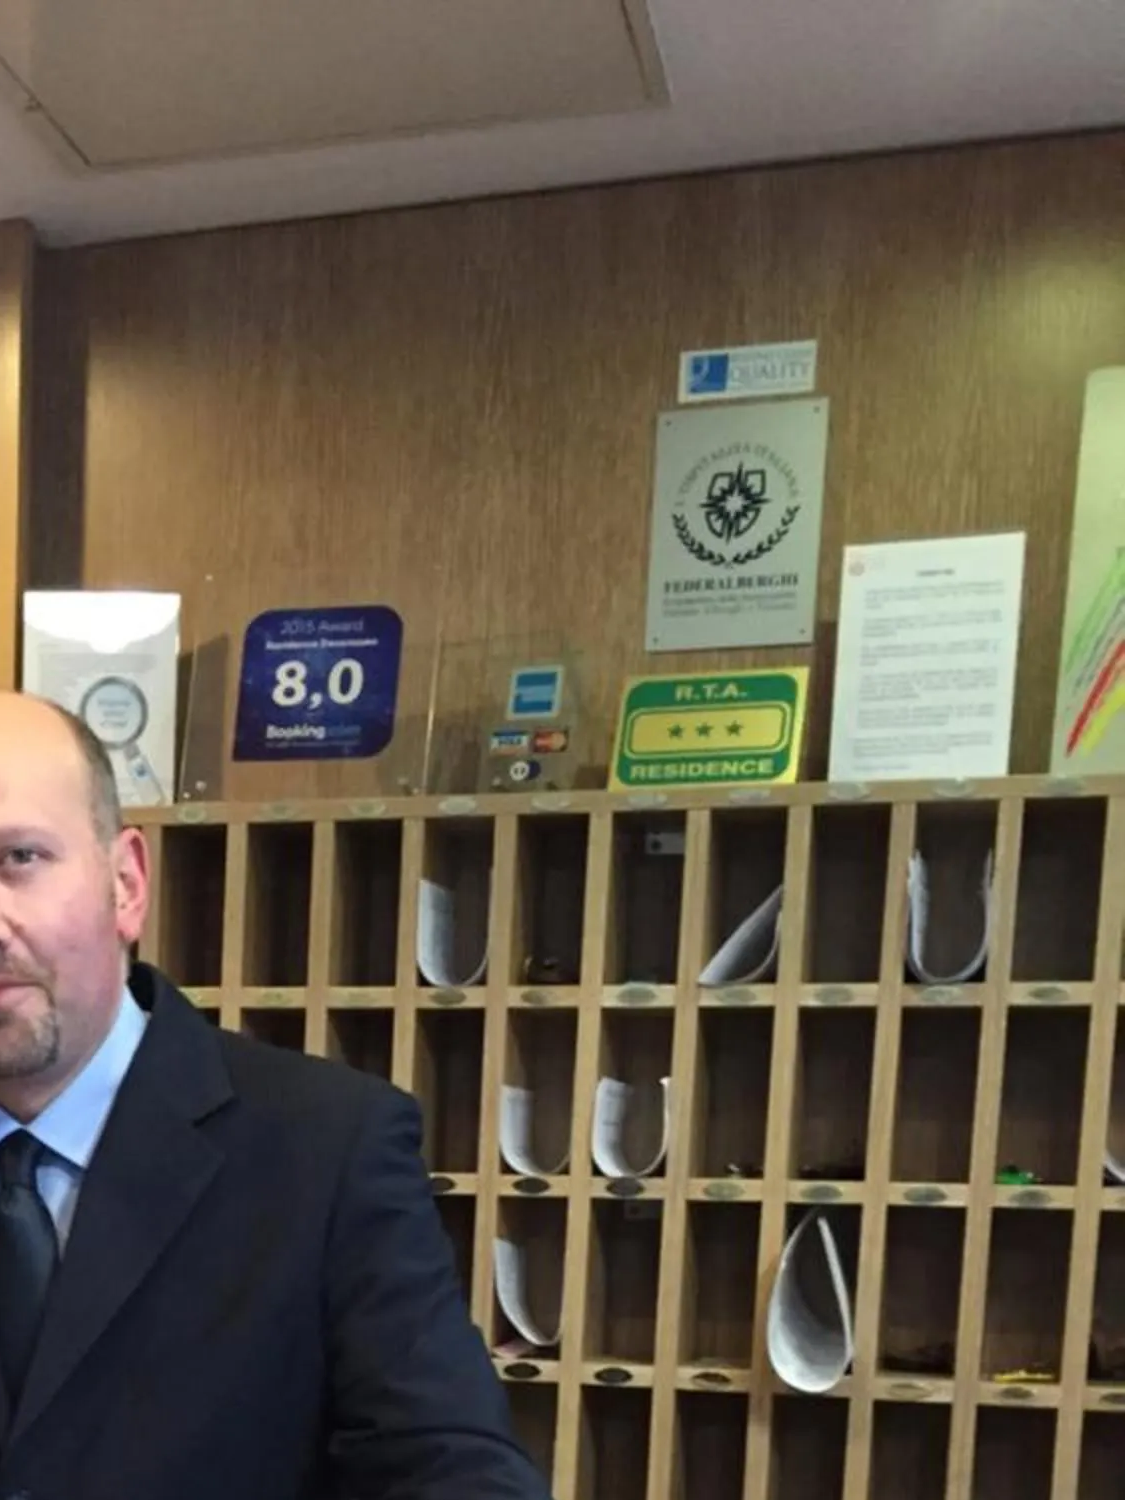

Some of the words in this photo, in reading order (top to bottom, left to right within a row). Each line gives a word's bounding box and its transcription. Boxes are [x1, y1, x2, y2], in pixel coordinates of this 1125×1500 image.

[663, 574, 799, 595] FEDERALBERGHI
[318, 615, 365, 633] Award
[272, 658, 364, 709] 8,0
[676, 682, 748, 701] R.T.A.
[630, 758, 774, 782] RESIDENCE
